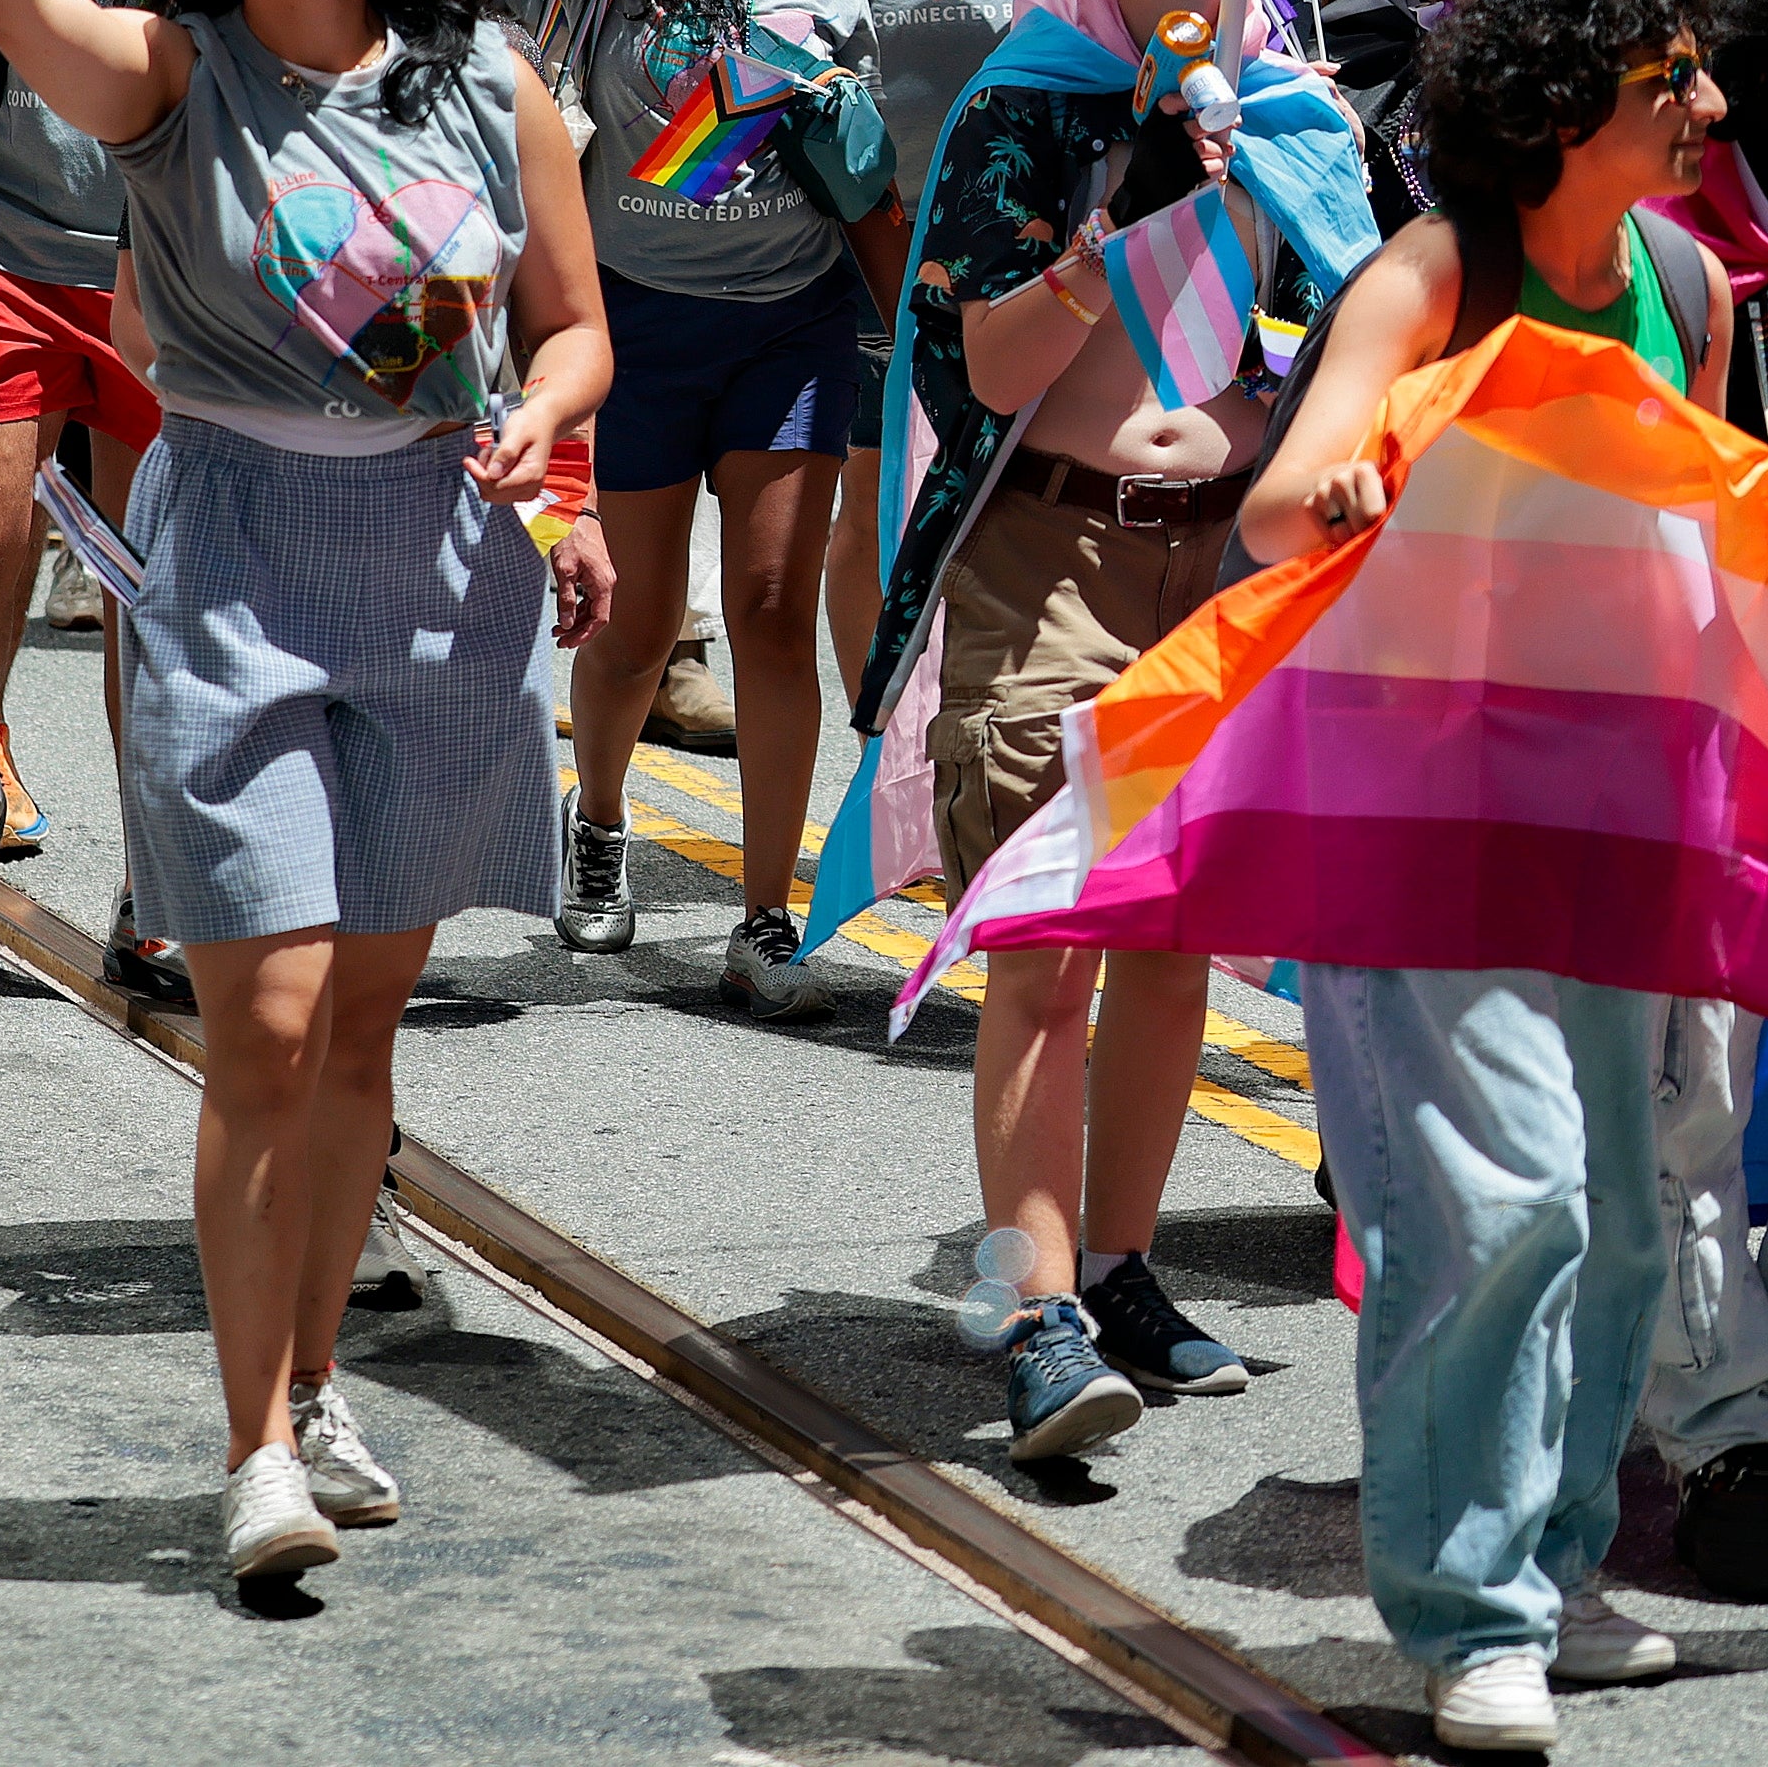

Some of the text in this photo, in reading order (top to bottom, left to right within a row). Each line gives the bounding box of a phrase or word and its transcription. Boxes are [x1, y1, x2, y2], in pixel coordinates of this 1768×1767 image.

[873, 3, 1002, 29] CONNECTED
[618, 186, 807, 222] CONNECTED BY PRID
